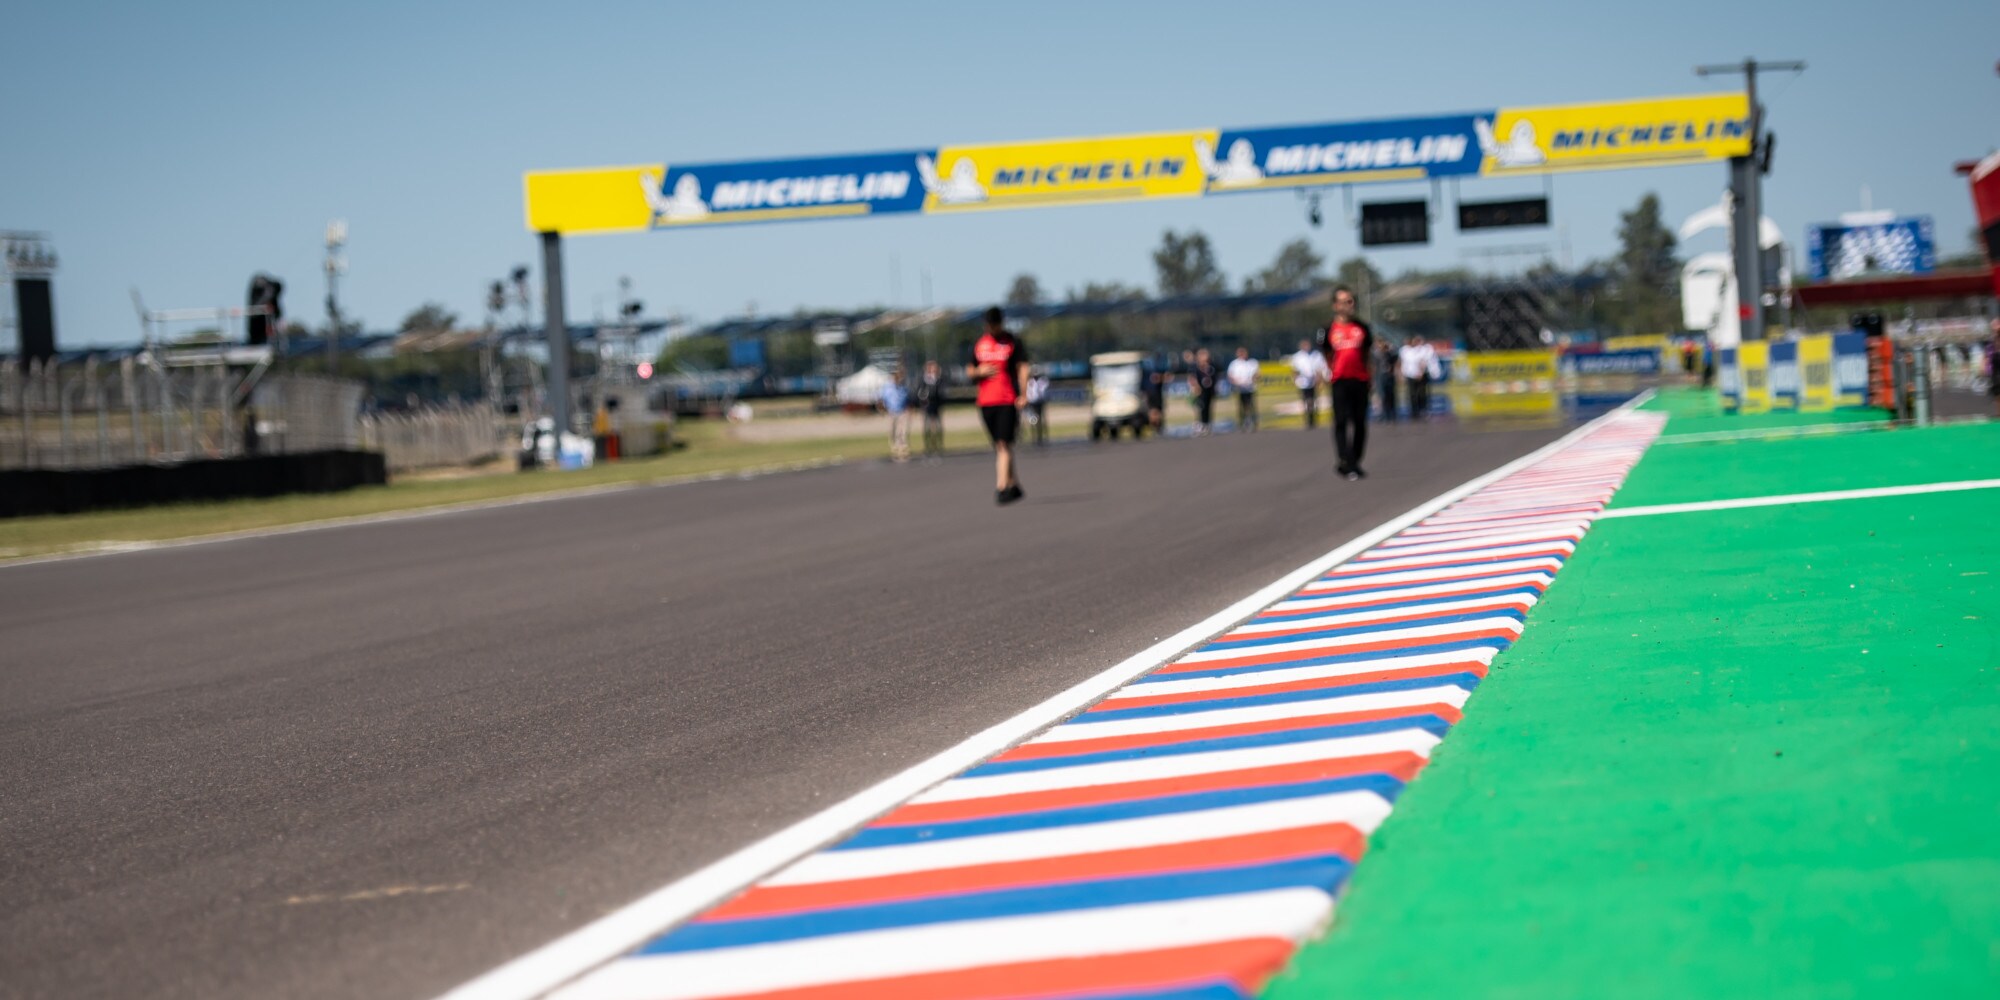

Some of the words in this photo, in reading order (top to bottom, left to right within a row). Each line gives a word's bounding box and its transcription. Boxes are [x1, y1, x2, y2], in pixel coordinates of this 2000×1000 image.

[1553, 117, 1750, 148] MICHELIN
[1264, 133, 1468, 174] MICHELIN
[992, 157, 1184, 187] MICHELIN
[711, 171, 911, 209] MICHELIN
